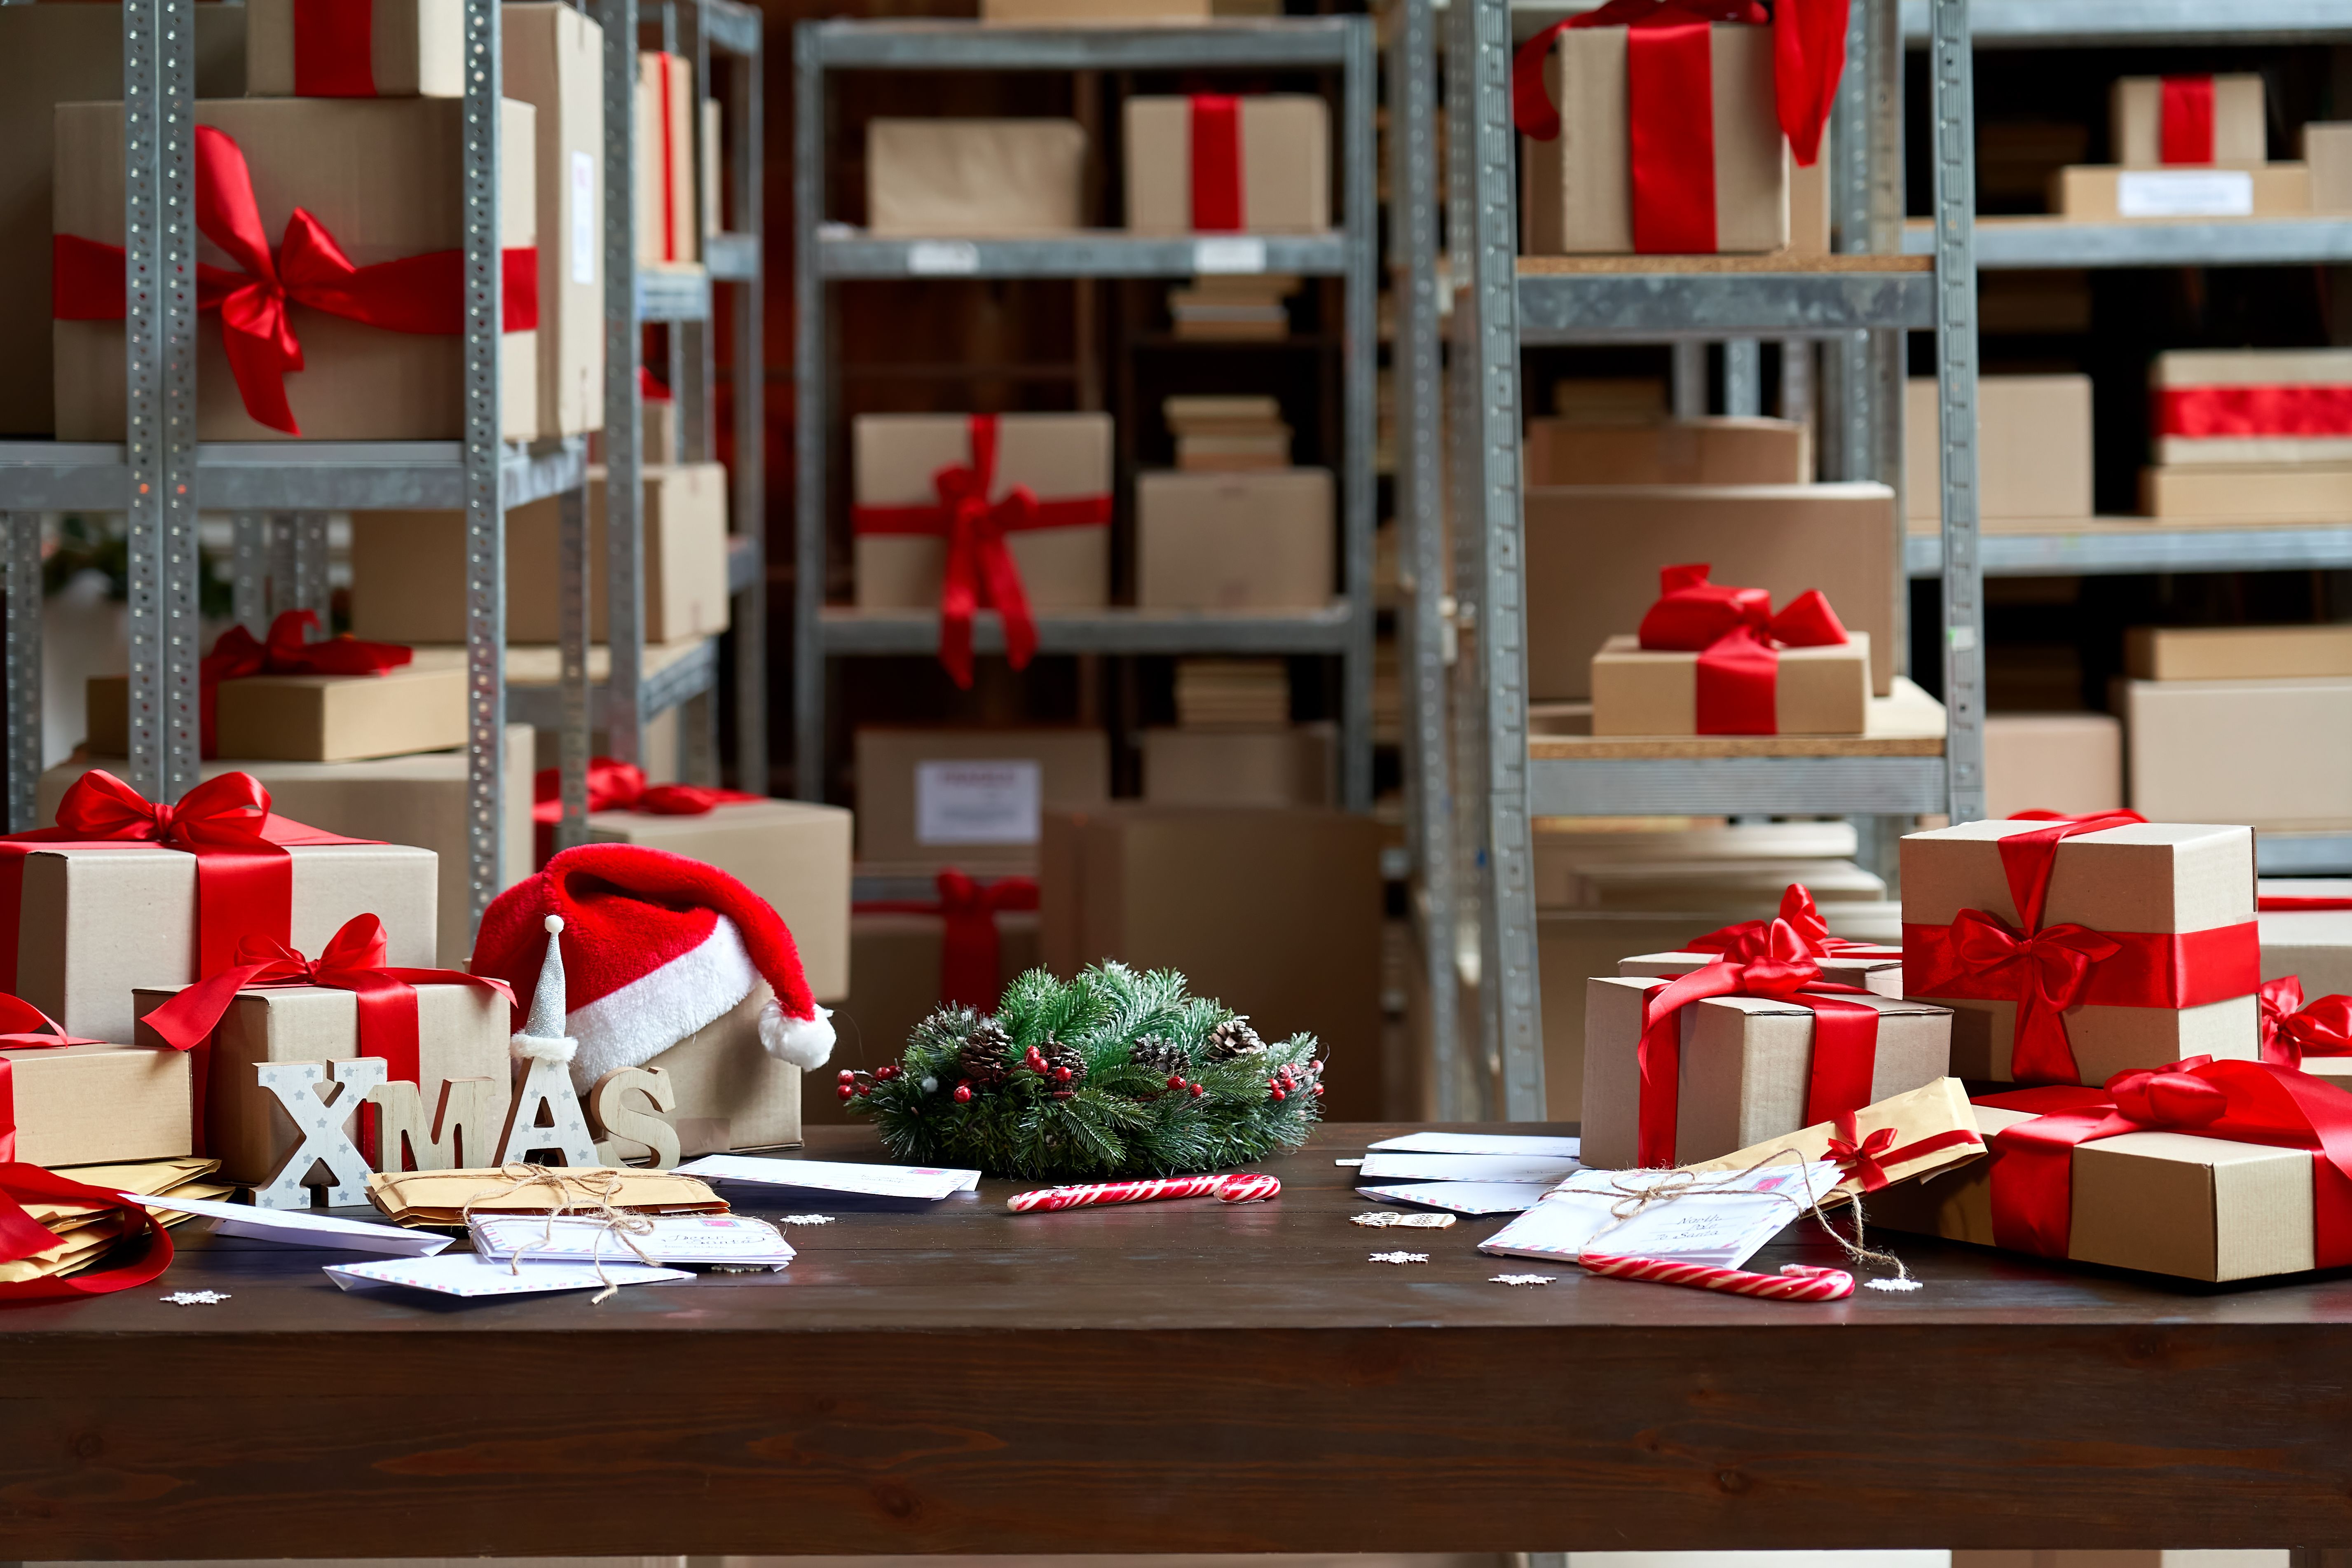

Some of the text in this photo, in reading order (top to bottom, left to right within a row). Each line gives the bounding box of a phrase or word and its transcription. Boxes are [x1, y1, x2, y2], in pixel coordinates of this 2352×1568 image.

[249, 1056, 681, 1210] XMAS
[1676, 1215, 1722, 1225] North
[1687, 1222, 1718, 1232] Pole
[1673, 1231, 1718, 1239] Santa
